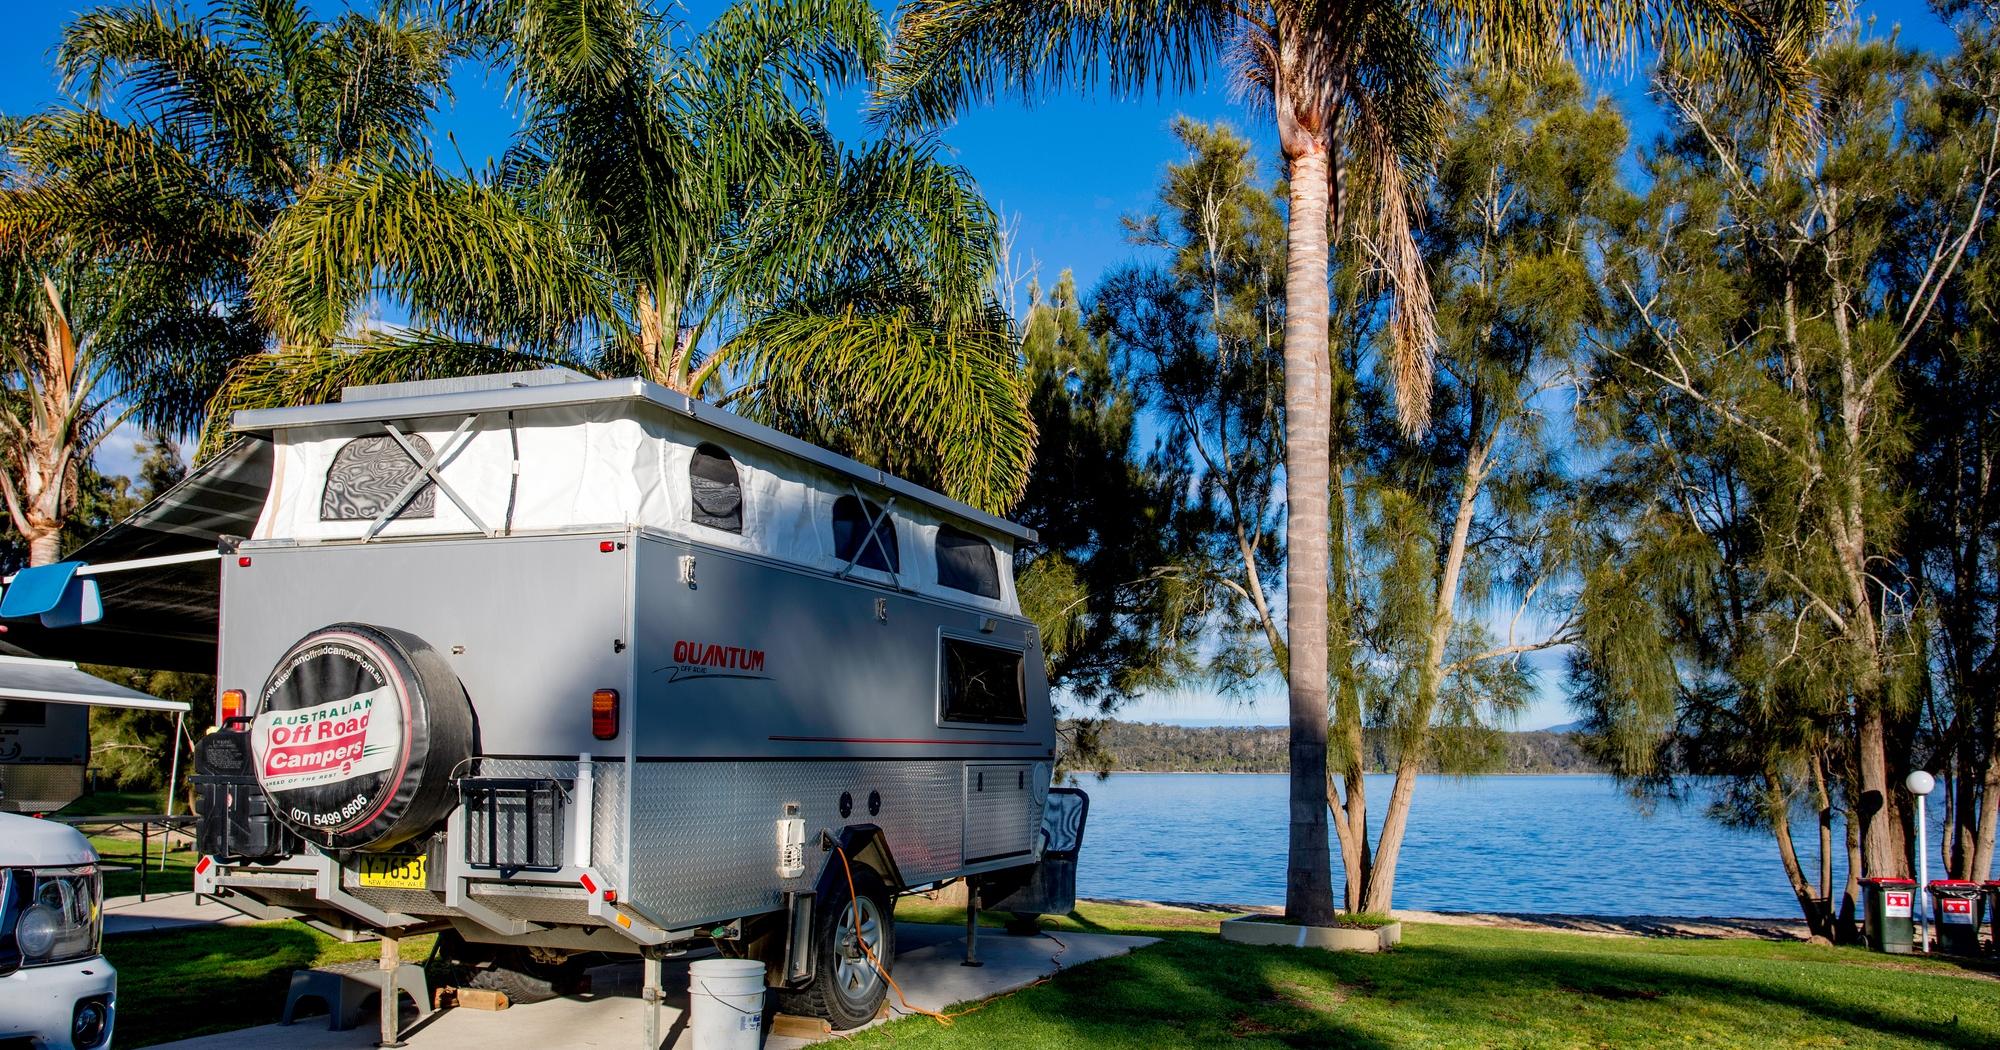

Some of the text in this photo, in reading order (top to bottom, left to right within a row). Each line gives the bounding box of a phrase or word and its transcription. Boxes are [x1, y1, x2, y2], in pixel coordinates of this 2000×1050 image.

[673, 640, 765, 671] QUANTUM
[272, 698, 373, 726] AUSTRALIAN
[272, 709, 371, 745] Off Road
[270, 740, 362, 769] Campers
[266, 779, 285, 787] AHEAD
[318, 772, 338, 780] REST
[291, 793, 368, 826] (07) 5499 6606
